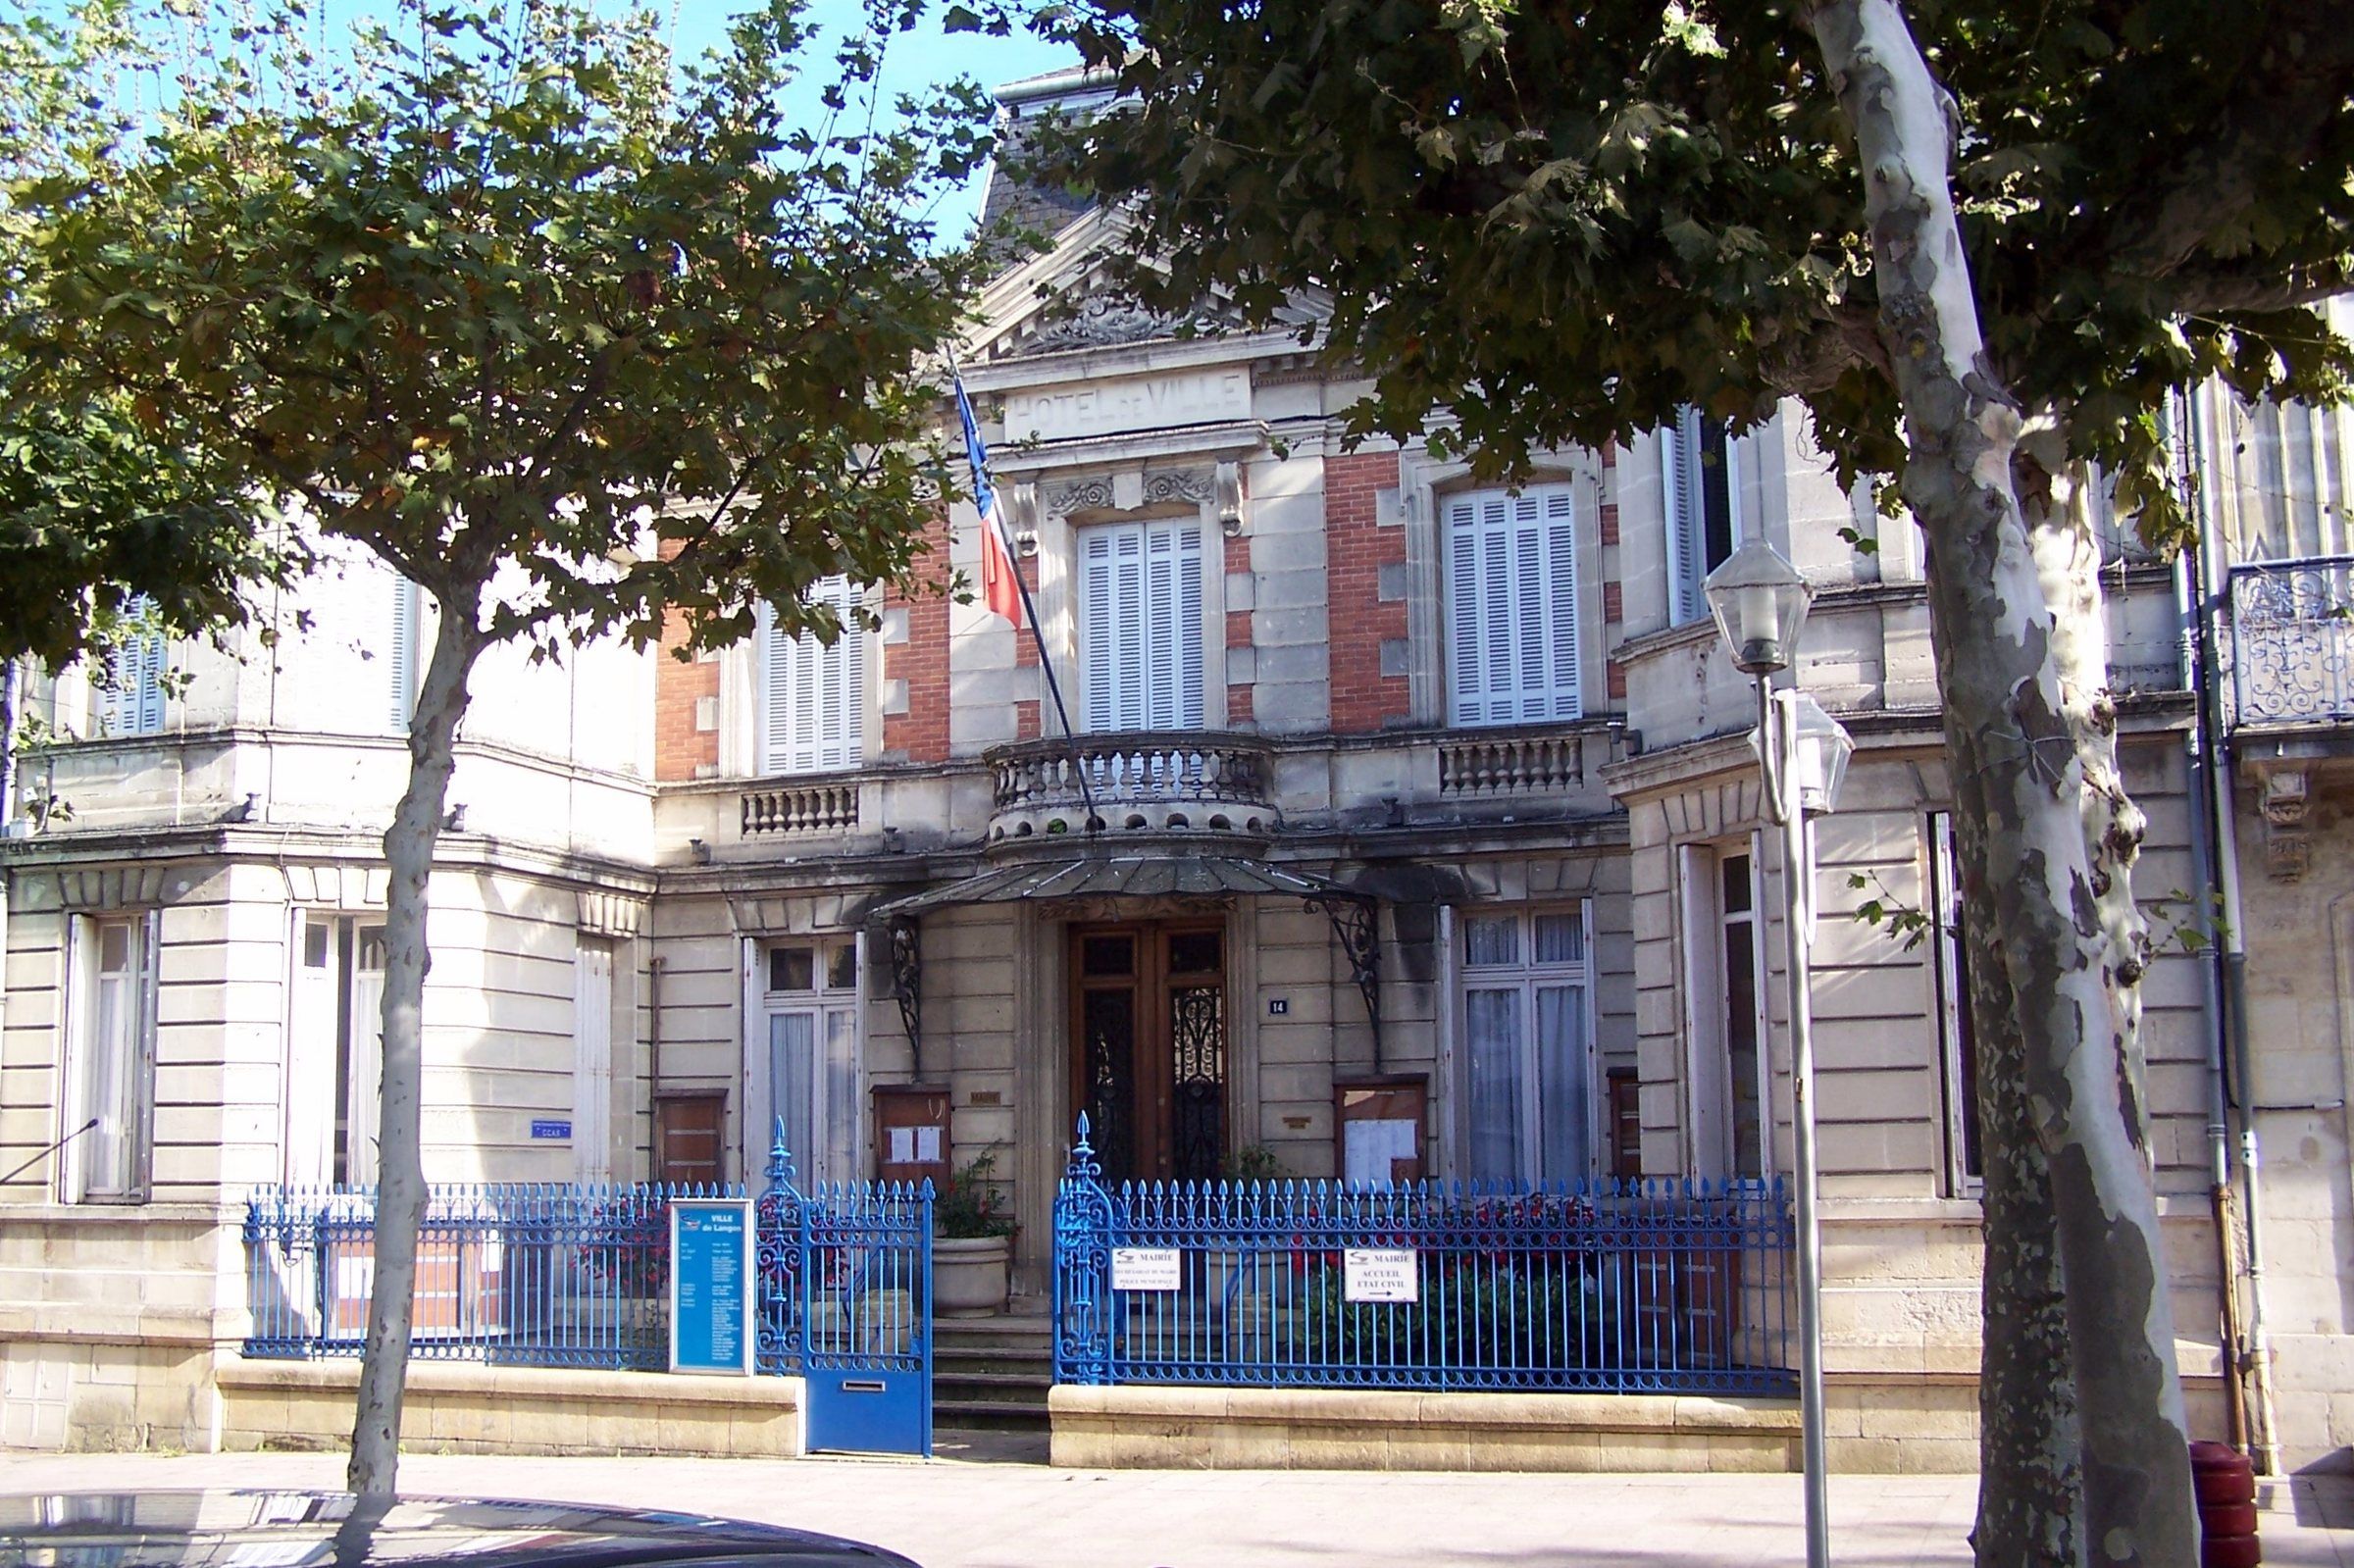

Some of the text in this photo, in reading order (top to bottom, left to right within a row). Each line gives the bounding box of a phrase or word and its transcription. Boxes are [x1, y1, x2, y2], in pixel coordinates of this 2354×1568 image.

[1146, 375, 1241, 412] VILLE
[1272, 1002, 1284, 1013] 14
[713, 1224, 742, 1234] Langon
[1140, 1253, 1173, 1262] MAIRIE
[1374, 1254, 1410, 1263] MAIRIE
